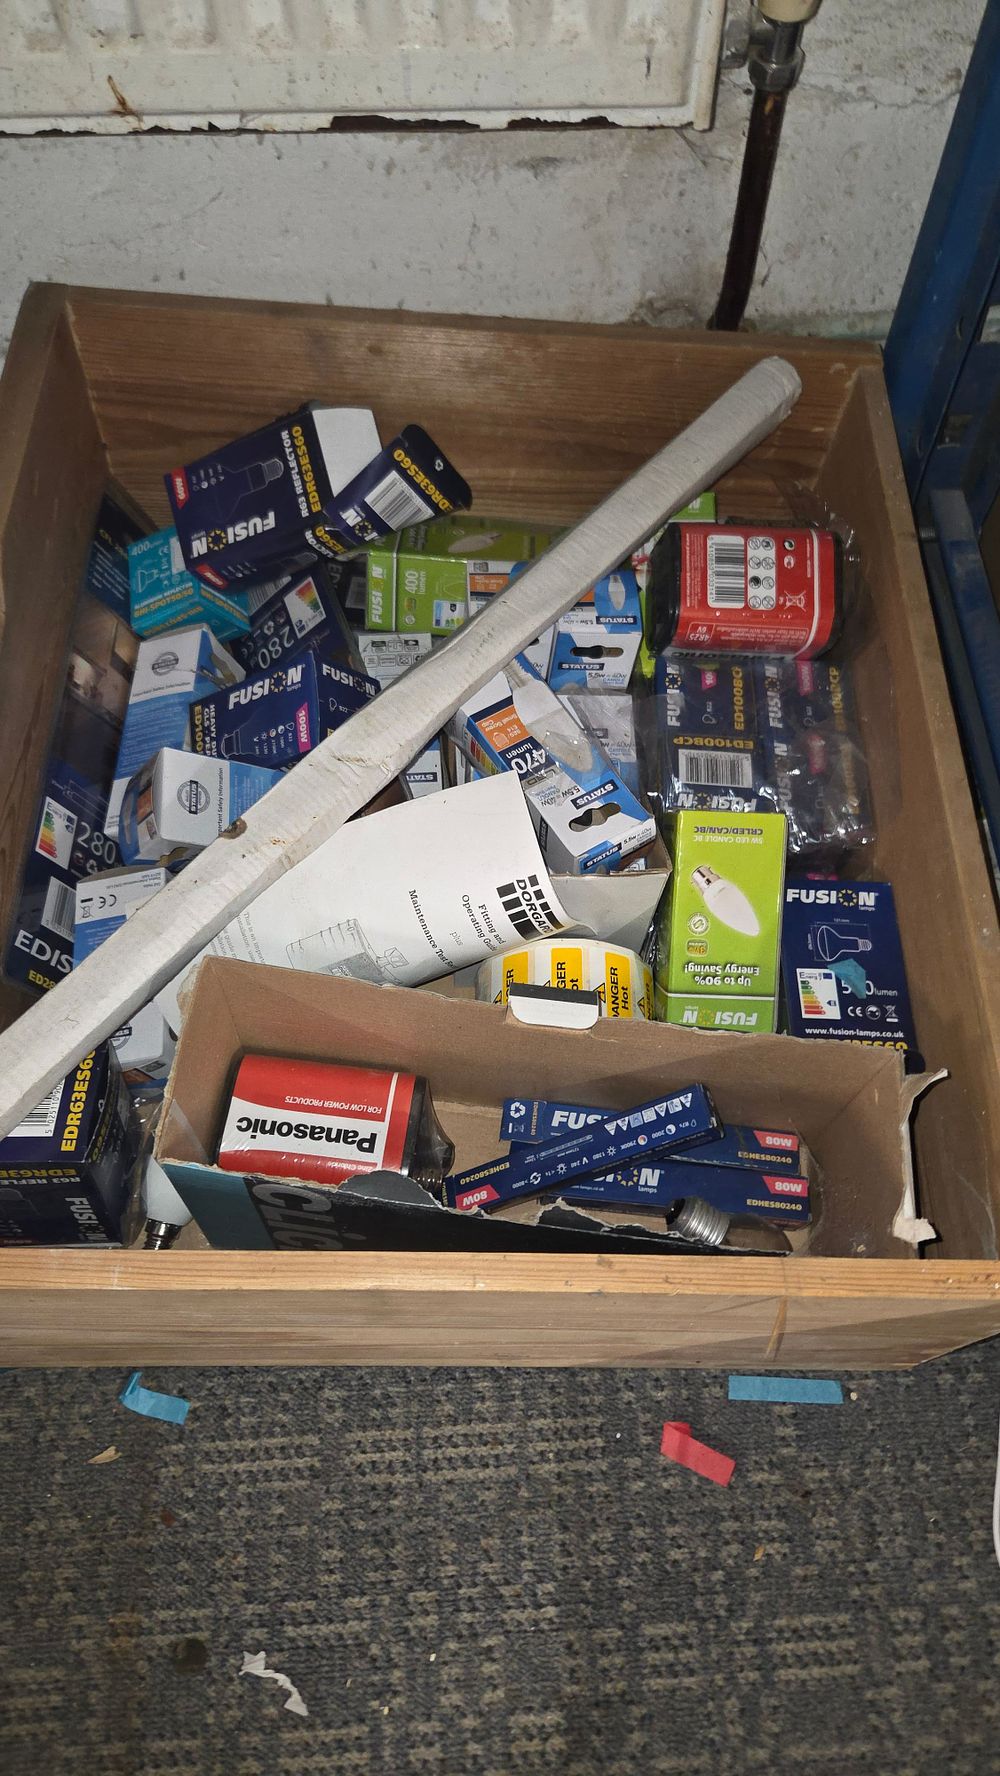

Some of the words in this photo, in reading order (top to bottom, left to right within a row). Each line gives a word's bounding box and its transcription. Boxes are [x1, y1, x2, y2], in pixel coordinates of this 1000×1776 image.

[280, 430, 303, 495] REFLECTOR
[291, 426, 322, 513] EDR63ES60
[190, 511, 277, 559] FUSION
[404, 570, 419, 594] 400
[600, 616, 635, 624] STATUS
[258, 626, 295, 669] 280
[228, 664, 303, 710] FUSION
[322, 663, 377, 697] FUSION
[764, 665, 785, 729] FUSION
[194, 704, 205, 755] ED100
[209, 704, 217, 738] HEAVY
[298, 710, 308, 743] 100W
[506, 742, 534, 759] lumen
[673, 736, 754, 750] ED100BCP
[510, 748, 547, 775] 470
[190, 782, 198, 813] STATUS
[575, 782, 615, 808] STATUS
[217, 797, 225, 813] Safety
[693, 826, 764, 836] CRLED/CAN/BC
[703, 835, 735, 844] CANDLE
[76, 820, 117, 865] 280
[735, 836, 752, 844] LED
[585, 845, 620, 867] STATUS
[786, 888, 876, 907] FUSION
[408, 889, 438, 949] Maintenance
[461, 894, 487, 940] Operating
[478, 903, 497, 933] Fitting
[493, 932, 505, 945] and
[684, 962, 723, 975] Saving!
[731, 964, 760, 977] Energy
[694, 976, 722, 986] 90%
[724, 977, 736, 986] to
[737, 976, 752, 987] Up
[841, 980, 874, 996] 50
[874, 988, 898, 997] lumen
[621, 985, 629, 1011] Hot
[682, 1009, 758, 1026] FUSION
[805, 1027, 905, 1039] www.fusion-lamps.co.uk
[284, 1095, 323, 1105] PRODUCTS
[323, 1100, 348, 1109] POWER
[349, 1102, 367, 1112] LOW
[367, 1105, 382, 1114] FOR
[236, 1116, 378, 1154] Panasonic
[765, 1136, 793, 1147] 80W
[737, 1151, 793, 1164] EDHES80240
[460, 1161, 511, 1186] EDHES80240
[774, 1181, 803, 1193] 80W
[463, 1190, 488, 1207] 80W
[746, 1198, 803, 1211] EDHES80240
